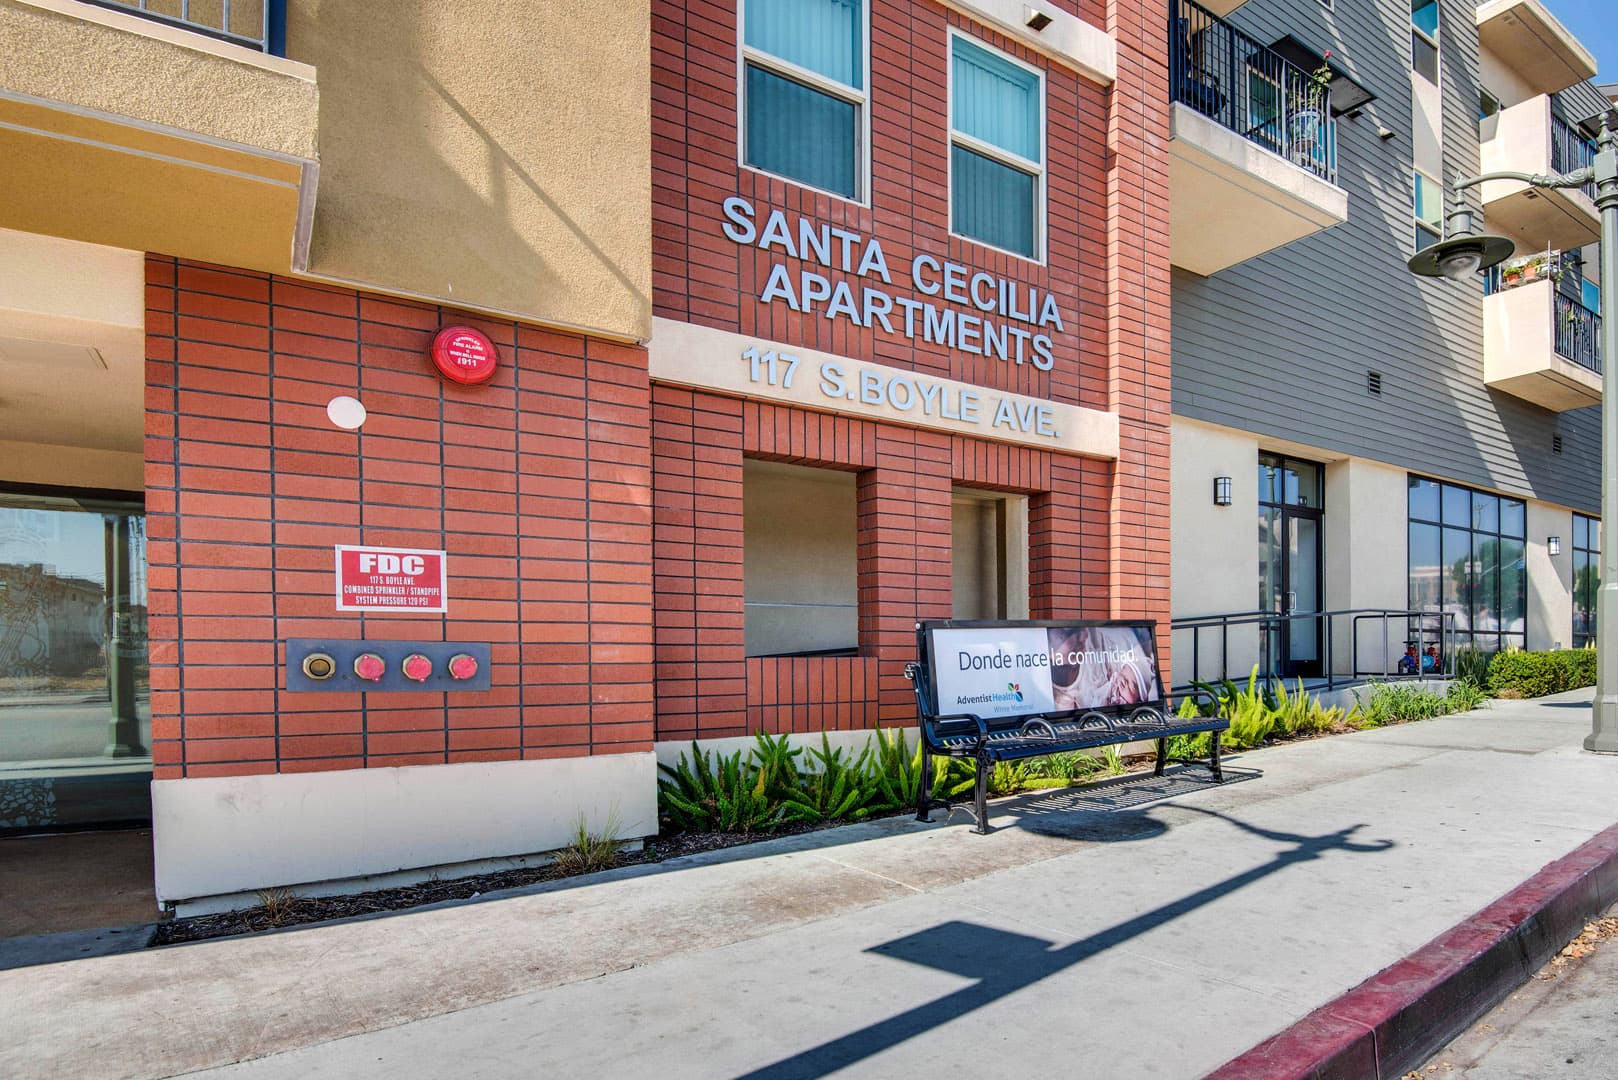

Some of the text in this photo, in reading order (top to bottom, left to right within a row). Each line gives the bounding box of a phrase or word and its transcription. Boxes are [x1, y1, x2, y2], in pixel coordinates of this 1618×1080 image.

[721, 196, 1064, 332] SANTA CECILIA
[760, 264, 1054, 372] APARTMENTS
[742, 346, 800, 388] 117
[993, 399, 1060, 438] AVE.
[360, 554, 424, 575] FDC
[344, 585, 374, 594] COMBINED
[376, 586, 405, 595] SPRINKLER
[411, 588, 440, 596] STANDPIPE
[356, 596, 378, 604] SYSTEM
[379, 597, 407, 605] PRESSURE
[958, 648, 1138, 670] Donde nace la comunidad.
